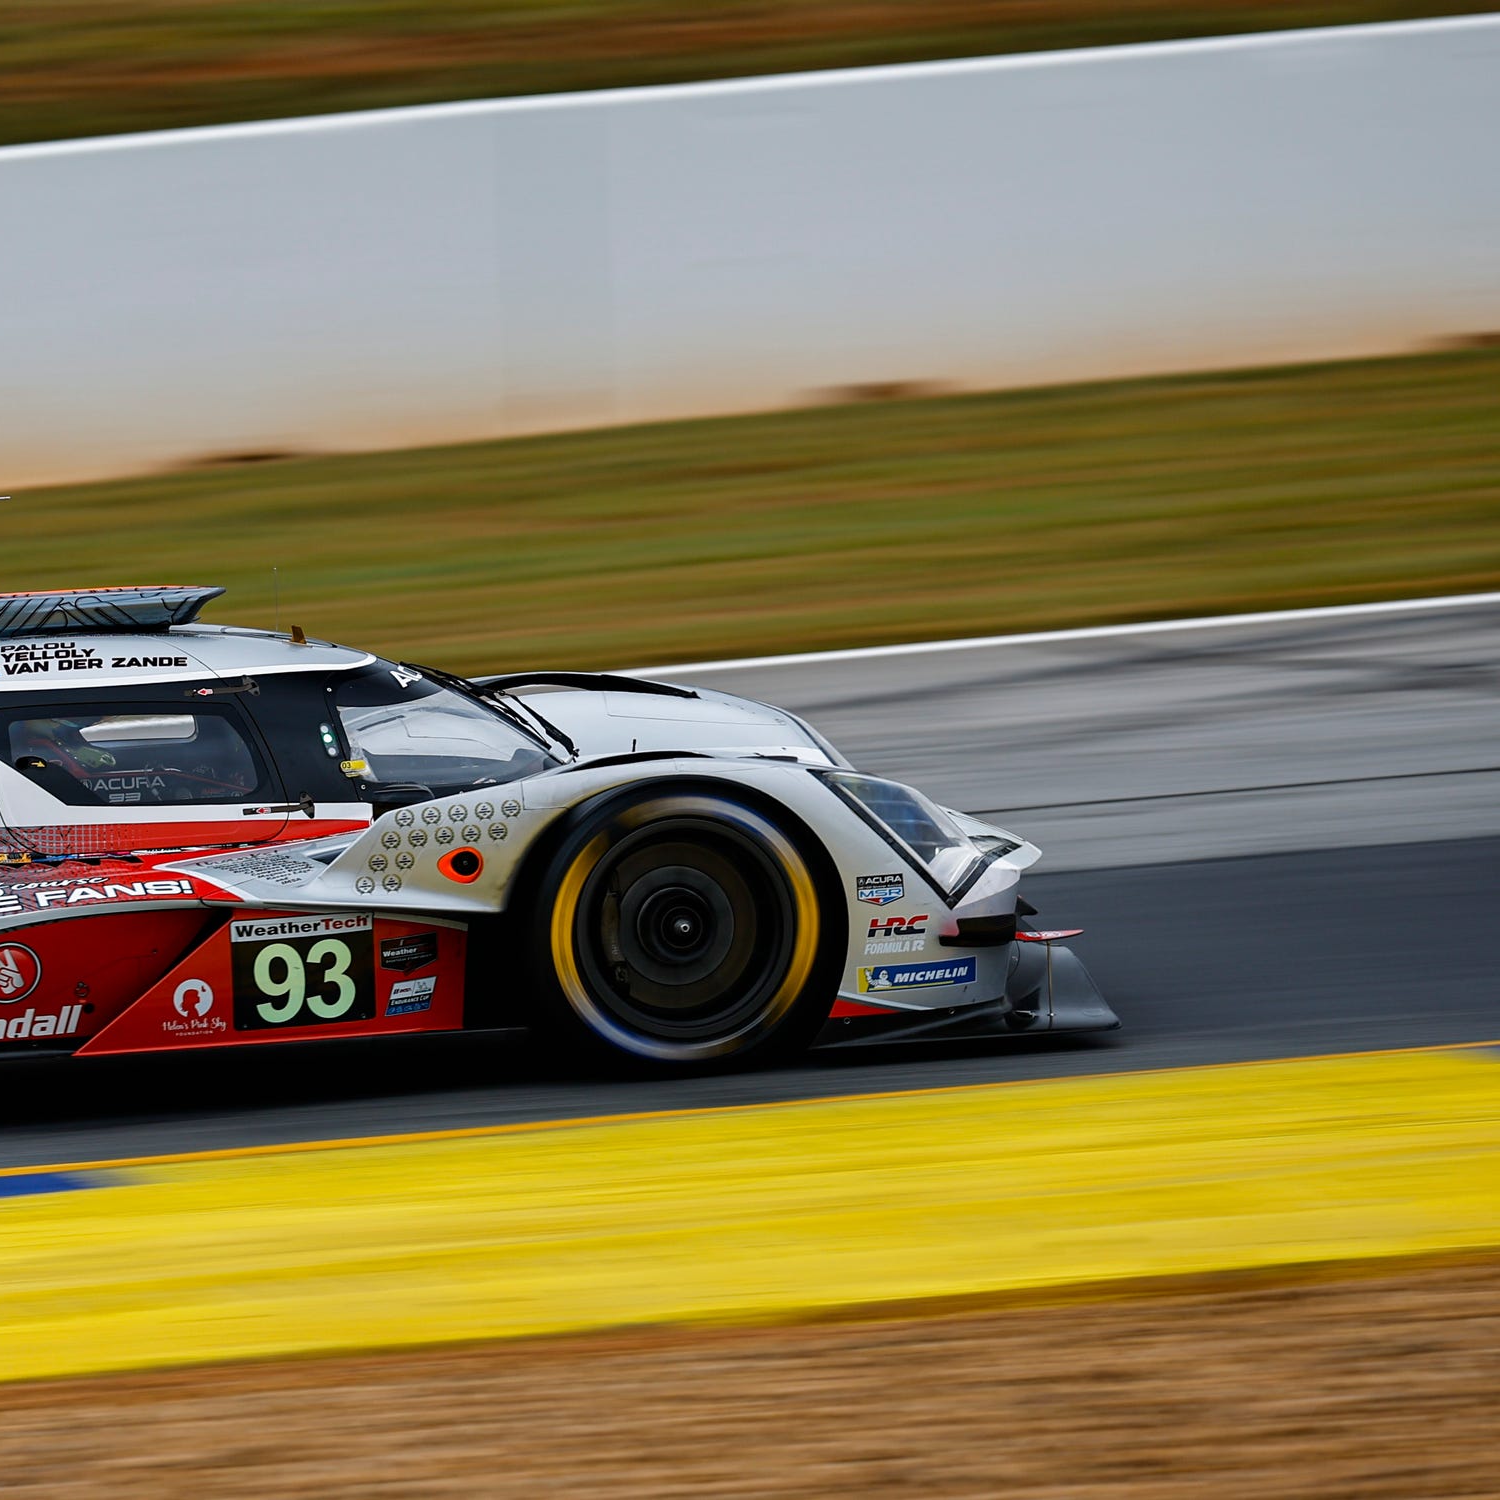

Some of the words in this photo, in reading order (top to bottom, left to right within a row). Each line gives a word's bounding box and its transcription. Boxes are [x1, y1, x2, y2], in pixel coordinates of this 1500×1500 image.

[0, 642, 76, 652] PALOU
[0, 648, 96, 663] YELLOLY
[3, 660, 49, 675] VAN
[57, 658, 104, 671] DER
[111, 656, 188, 668] ZANDE
[94, 776, 166, 791] ACURA
[109, 792, 141, 803] 93
[11, 877, 109, 891] course
[865, 875, 902, 884] ACURA
[35, 879, 195, 908] FANS!
[860, 888, 902, 898] MSR
[235, 915, 369, 938] WeatherTech
[867, 915, 929, 938] HRC
[863, 942, 910, 955] FORMULA
[253, 938, 357, 1024] 93
[893, 966, 969, 983] MICHELIN
[210, 1016, 227, 1032] Sky
